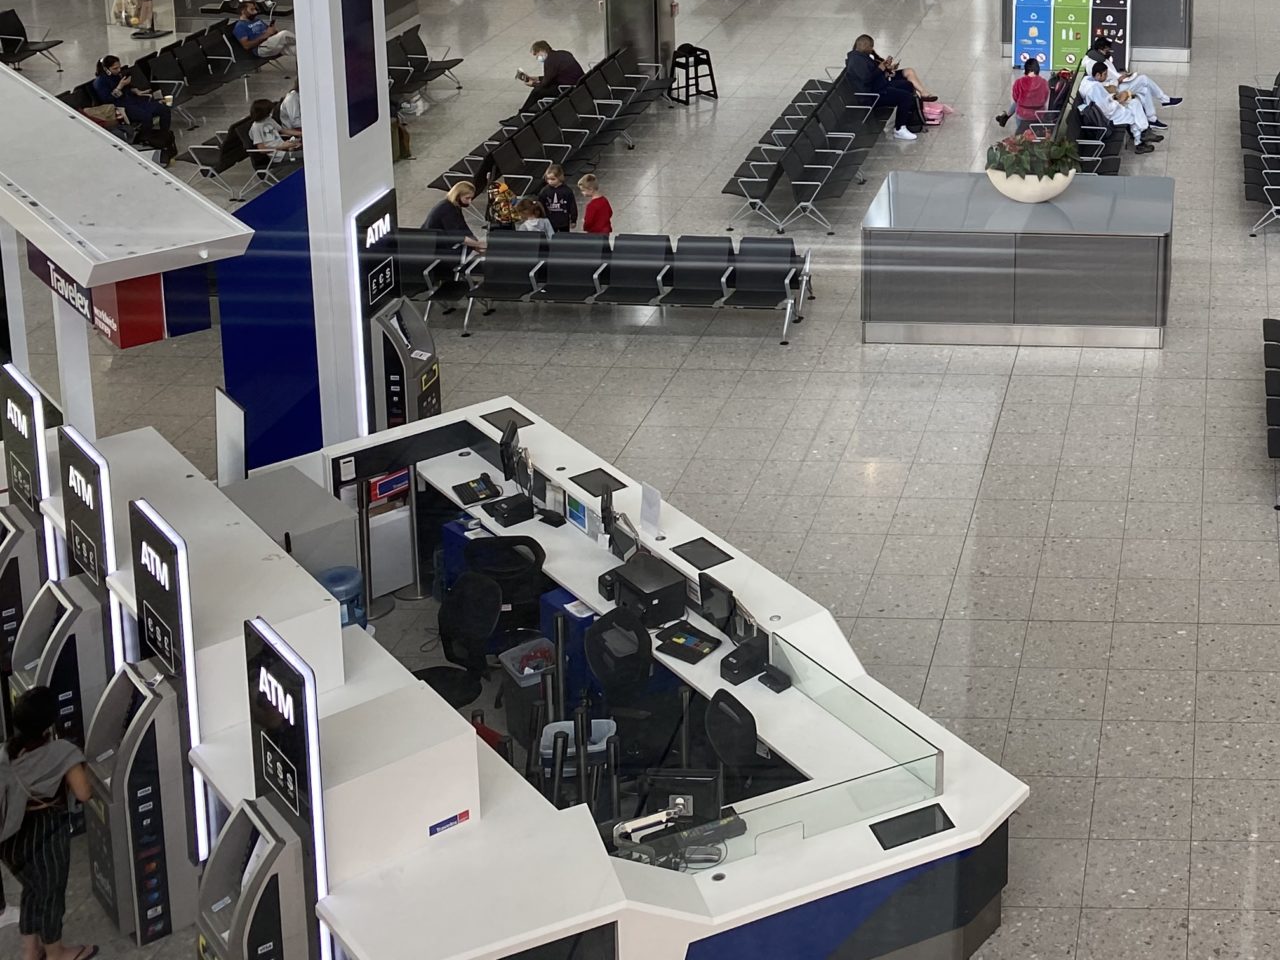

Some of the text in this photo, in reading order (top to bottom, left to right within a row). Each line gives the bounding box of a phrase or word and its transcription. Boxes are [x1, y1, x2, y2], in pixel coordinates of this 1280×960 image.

[366, 212, 391, 248] ATM
[47, 260, 91, 319] Travelex
[7, 398, 28, 439] ATM
[68, 465, 94, 511] ATM
[141, 540, 170, 592] ATM
[259, 666, 295, 726] ATM
